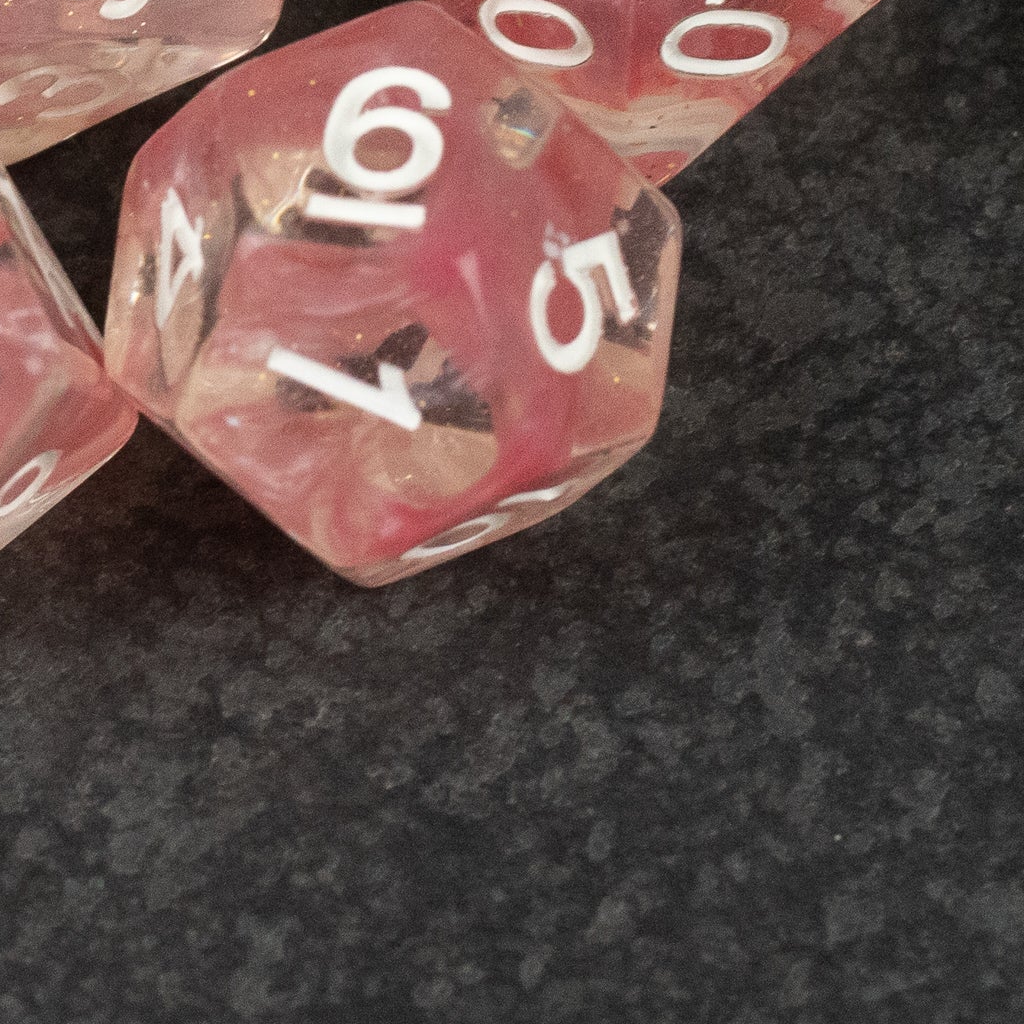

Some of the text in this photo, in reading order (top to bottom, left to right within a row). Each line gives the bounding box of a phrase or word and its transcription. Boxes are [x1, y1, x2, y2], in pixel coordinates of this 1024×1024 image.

[303, 66, 452, 230] 6
[155, 187, 205, 331] 4
[530, 229, 640, 374] 5
[267, 347, 422, 430] 1
